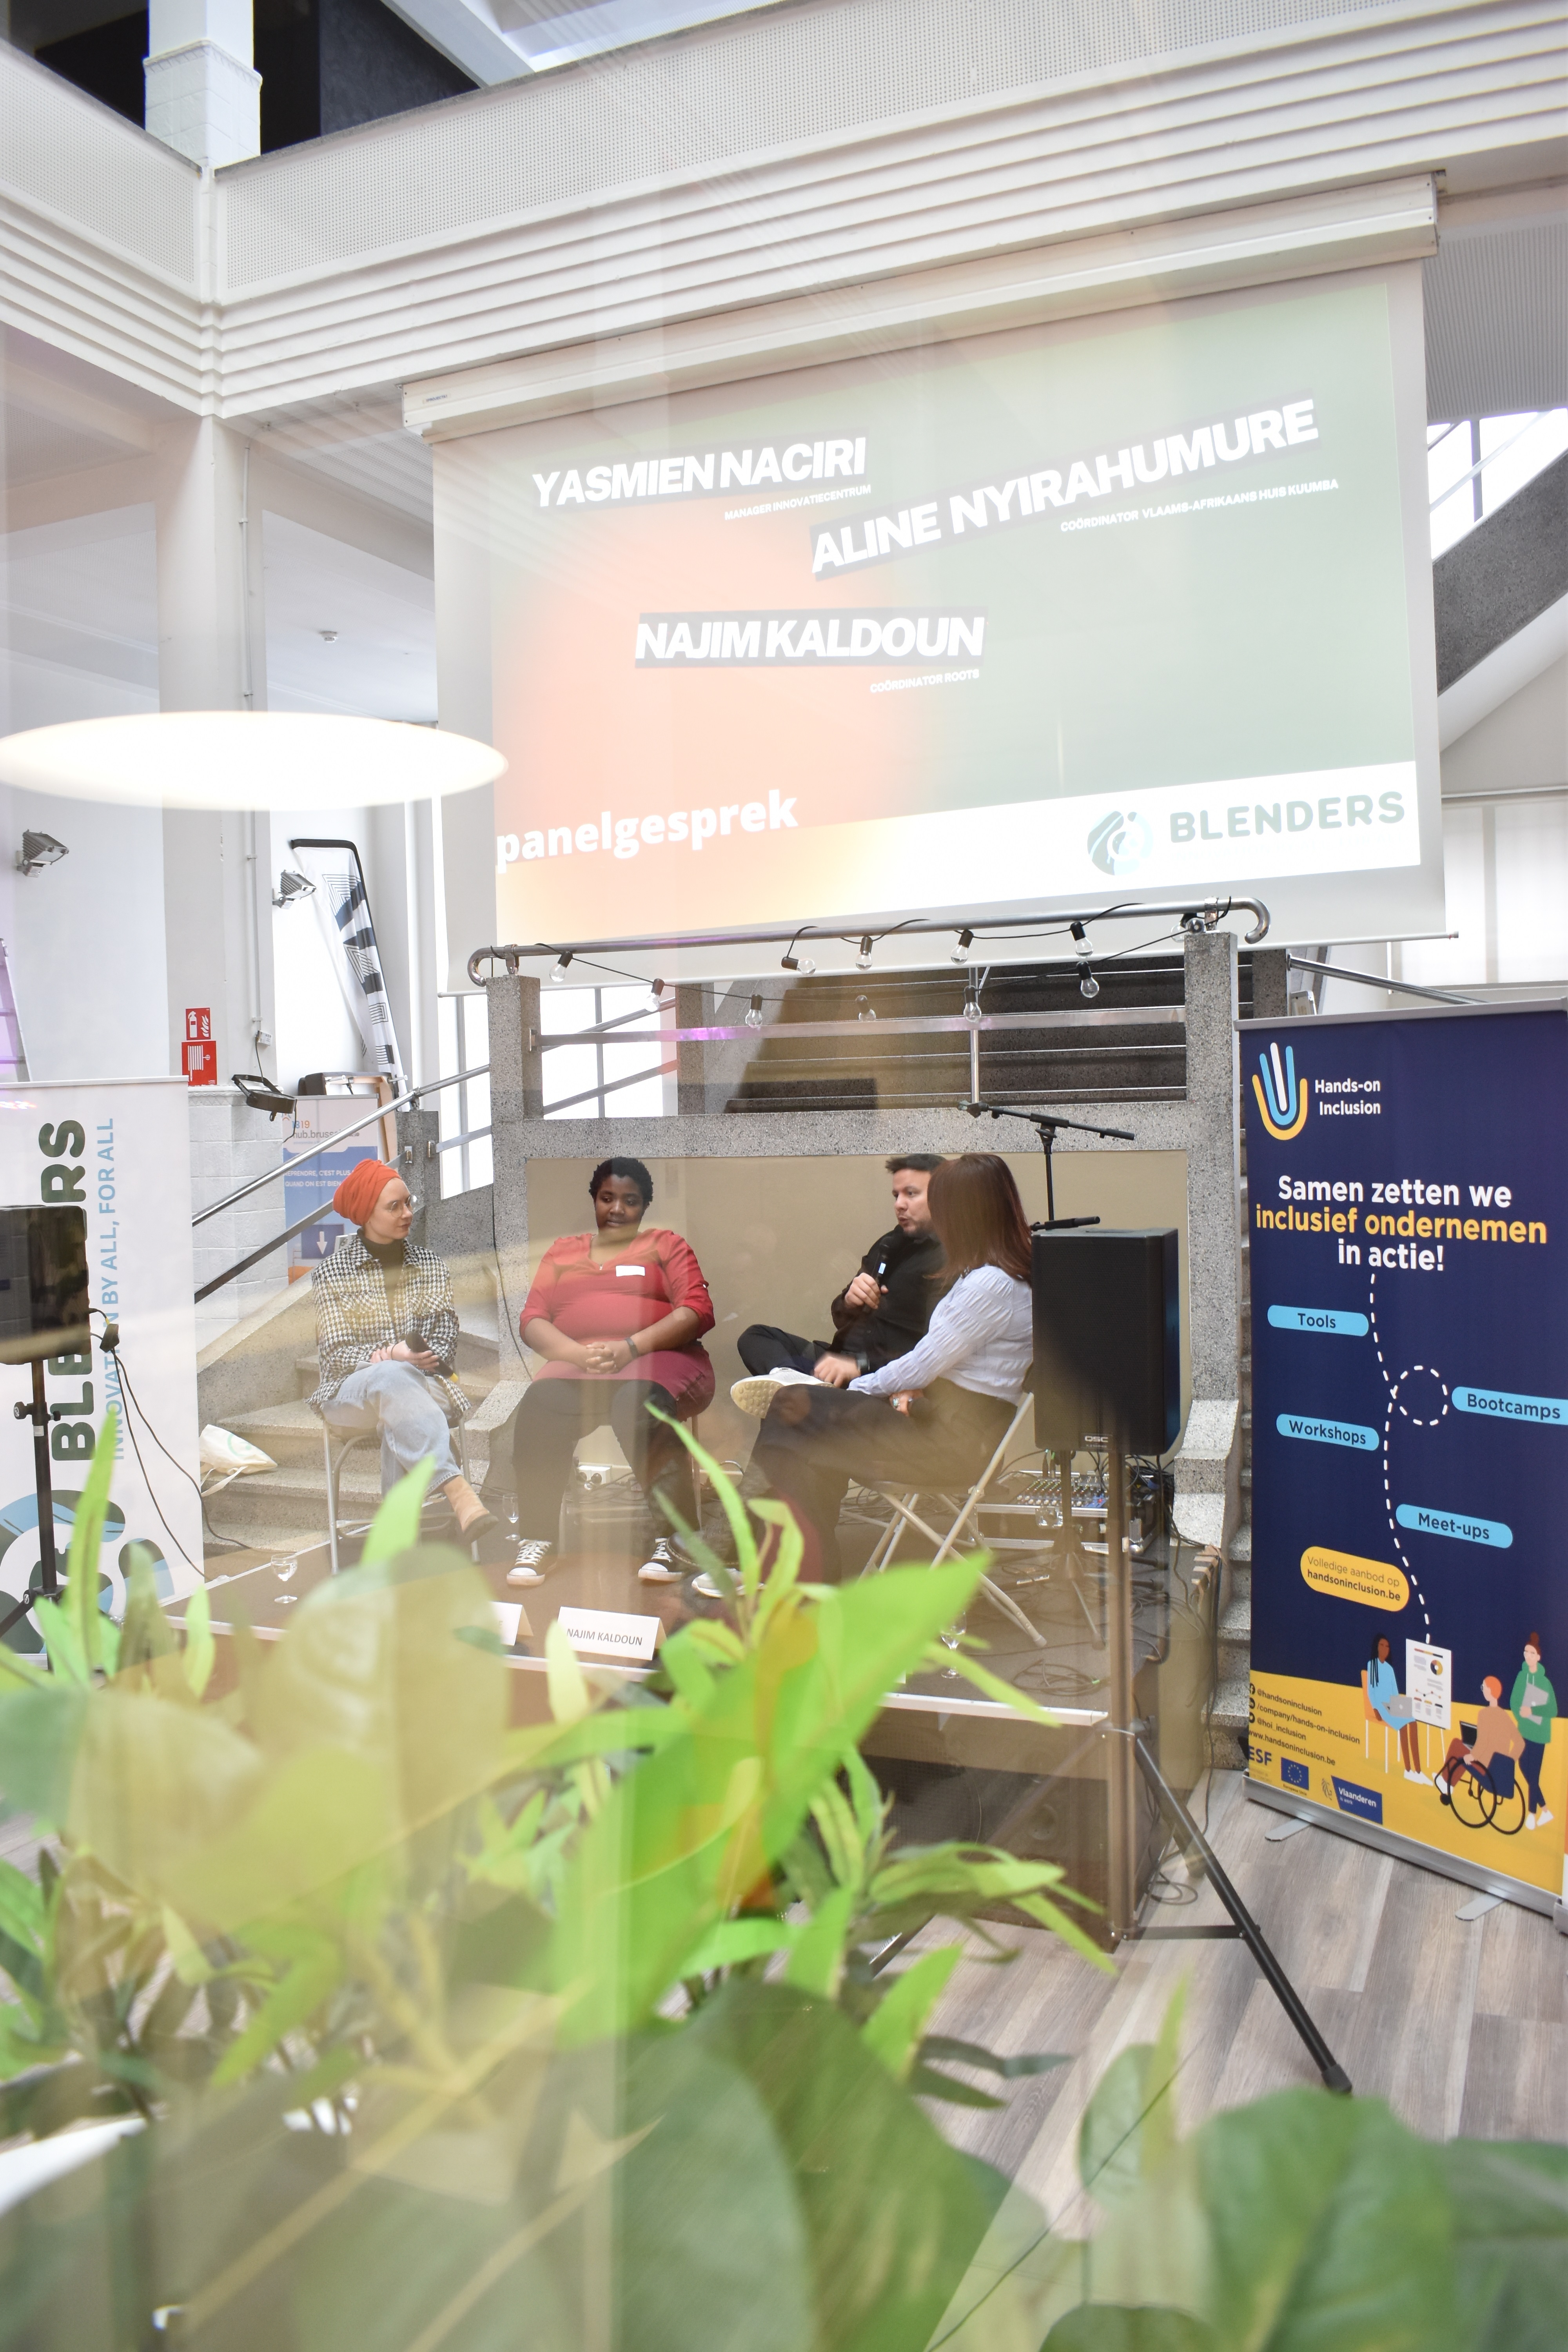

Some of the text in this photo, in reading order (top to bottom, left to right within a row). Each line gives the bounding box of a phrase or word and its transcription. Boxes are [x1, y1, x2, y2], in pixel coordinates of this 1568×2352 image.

[532, 437, 866, 507] YASMIEN NACIRI
[812, 399, 1319, 573] ALINE NYIRAHUMURE
[724, 484, 871, 521] MANAGER INNOVATIECENTRUM
[1060, 479, 1339, 532] COÖRDINATOR VLAAMS-AFRIKAANS HUIS KUUMBA
[635, 617, 985, 659] NAJIM KALDOUN
[945, 669, 980, 682] ROOTS
[497, 789, 799, 874] panelgesprek
[1169, 791, 1405, 843] BLENDERS
[1315, 1078, 1381, 1093] Hands-on
[1319, 1100, 1381, 1116] Inclusion
[97, 1118, 114, 1161] ALL
[98, 1167, 115, 1214] FOR
[1278, 1176, 1512, 1208] Samen zetten we
[1256, 1204, 1547, 1244] inclusief ondernemen
[100, 1221, 120, 1270] ALL,
[1338, 1239, 1445, 1271] in actie!
[101, 1277, 118, 1304] BY
[1297, 1313, 1337, 1329] Tools
[1467, 1393, 1561, 1421] Bootcamps
[1289, 1420, 1367, 1445] Workshops
[1418, 1513, 1490, 1540] Meet-ups
[1307, 1555, 1400, 1588] Volledige aanbod op
[1307, 1569, 1401, 1601] handsoninclusion.be
[567, 1628, 643, 1646] NAJIM KALDOUN
[1257, 1688, 1322, 1716] @handsoninclusion
[1257, 1703, 1360, 1744] /company/hands-on-inclusion
[1257, 1718, 1306, 1740] @hoi_inclusion
[1249, 1745, 1272, 1766] ESF
[1338, 1787, 1376, 1808] Vlaanderen
